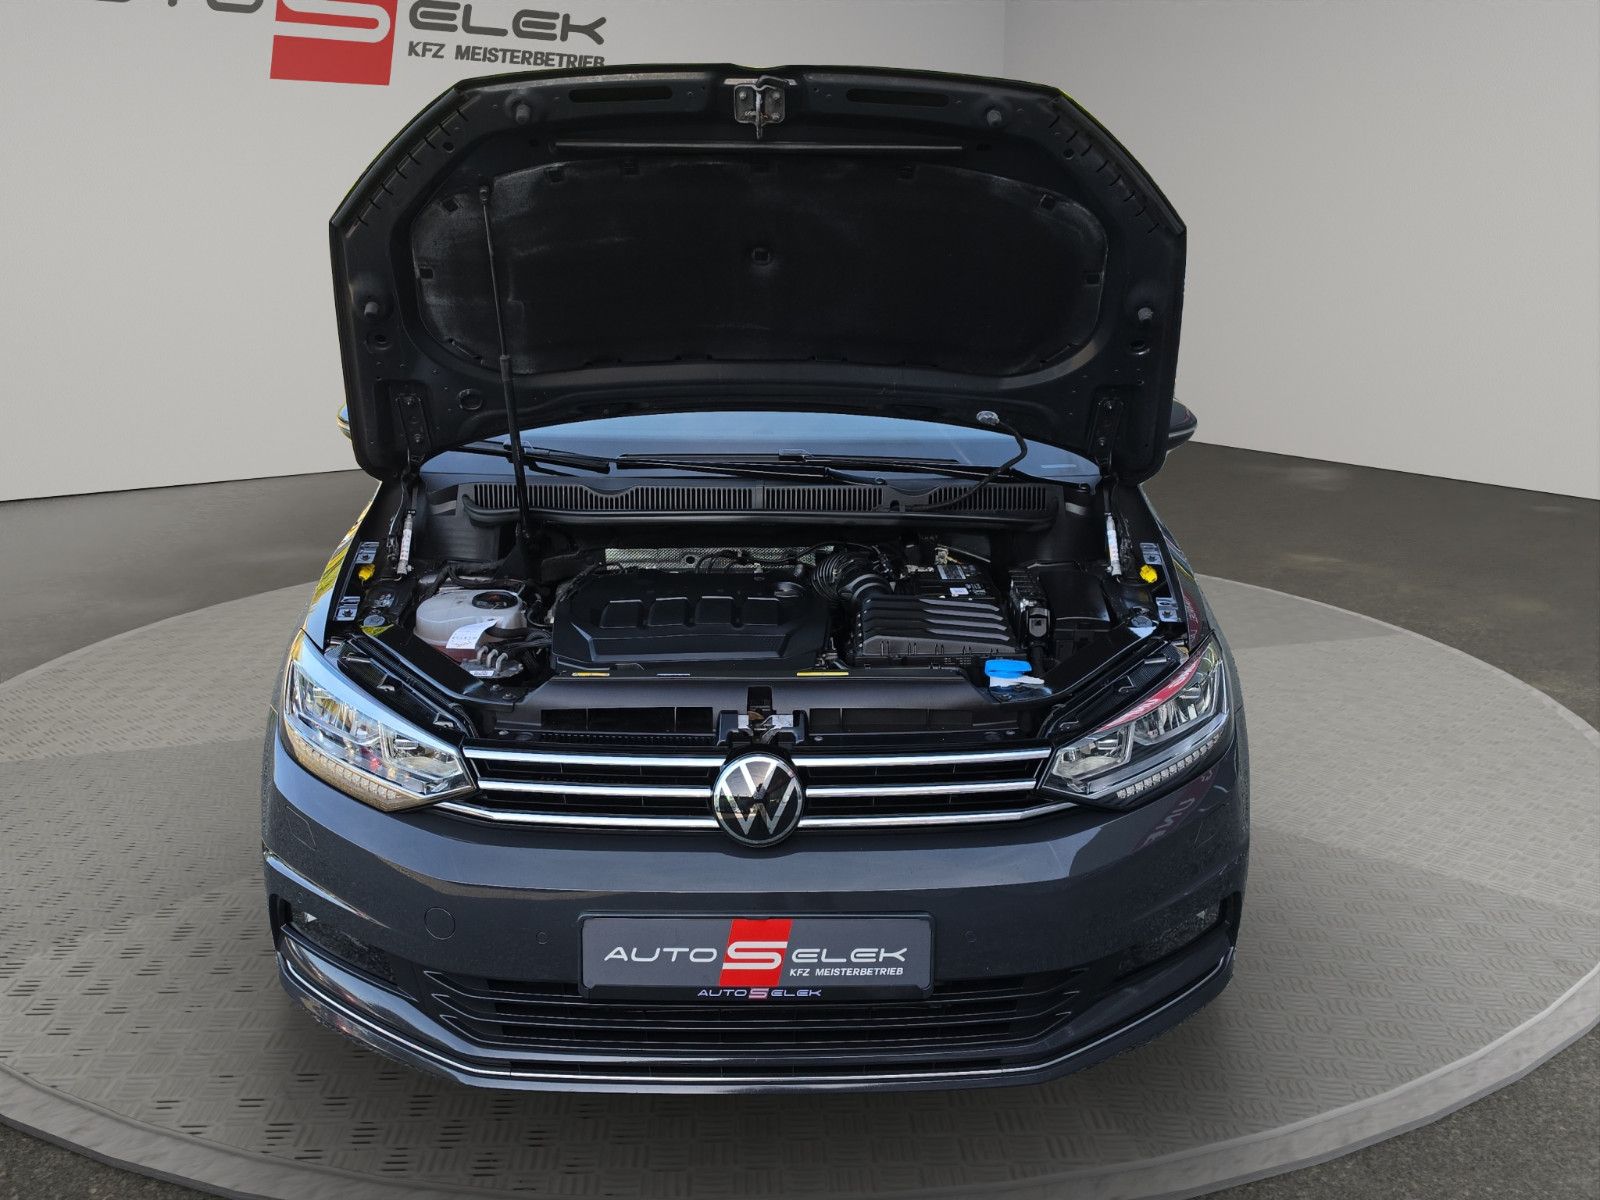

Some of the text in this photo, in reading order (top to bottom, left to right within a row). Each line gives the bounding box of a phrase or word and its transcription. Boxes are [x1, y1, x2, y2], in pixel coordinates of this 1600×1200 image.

[408, 41, 606, 68] KFZ MEISTERBETRIEB
[717, 754, 800, 842] VW
[604, 947, 717, 962] AUTO
[789, 967, 904, 977] KFZ MEISTERBETRIEB
[697, 989, 747, 997] AUTO
